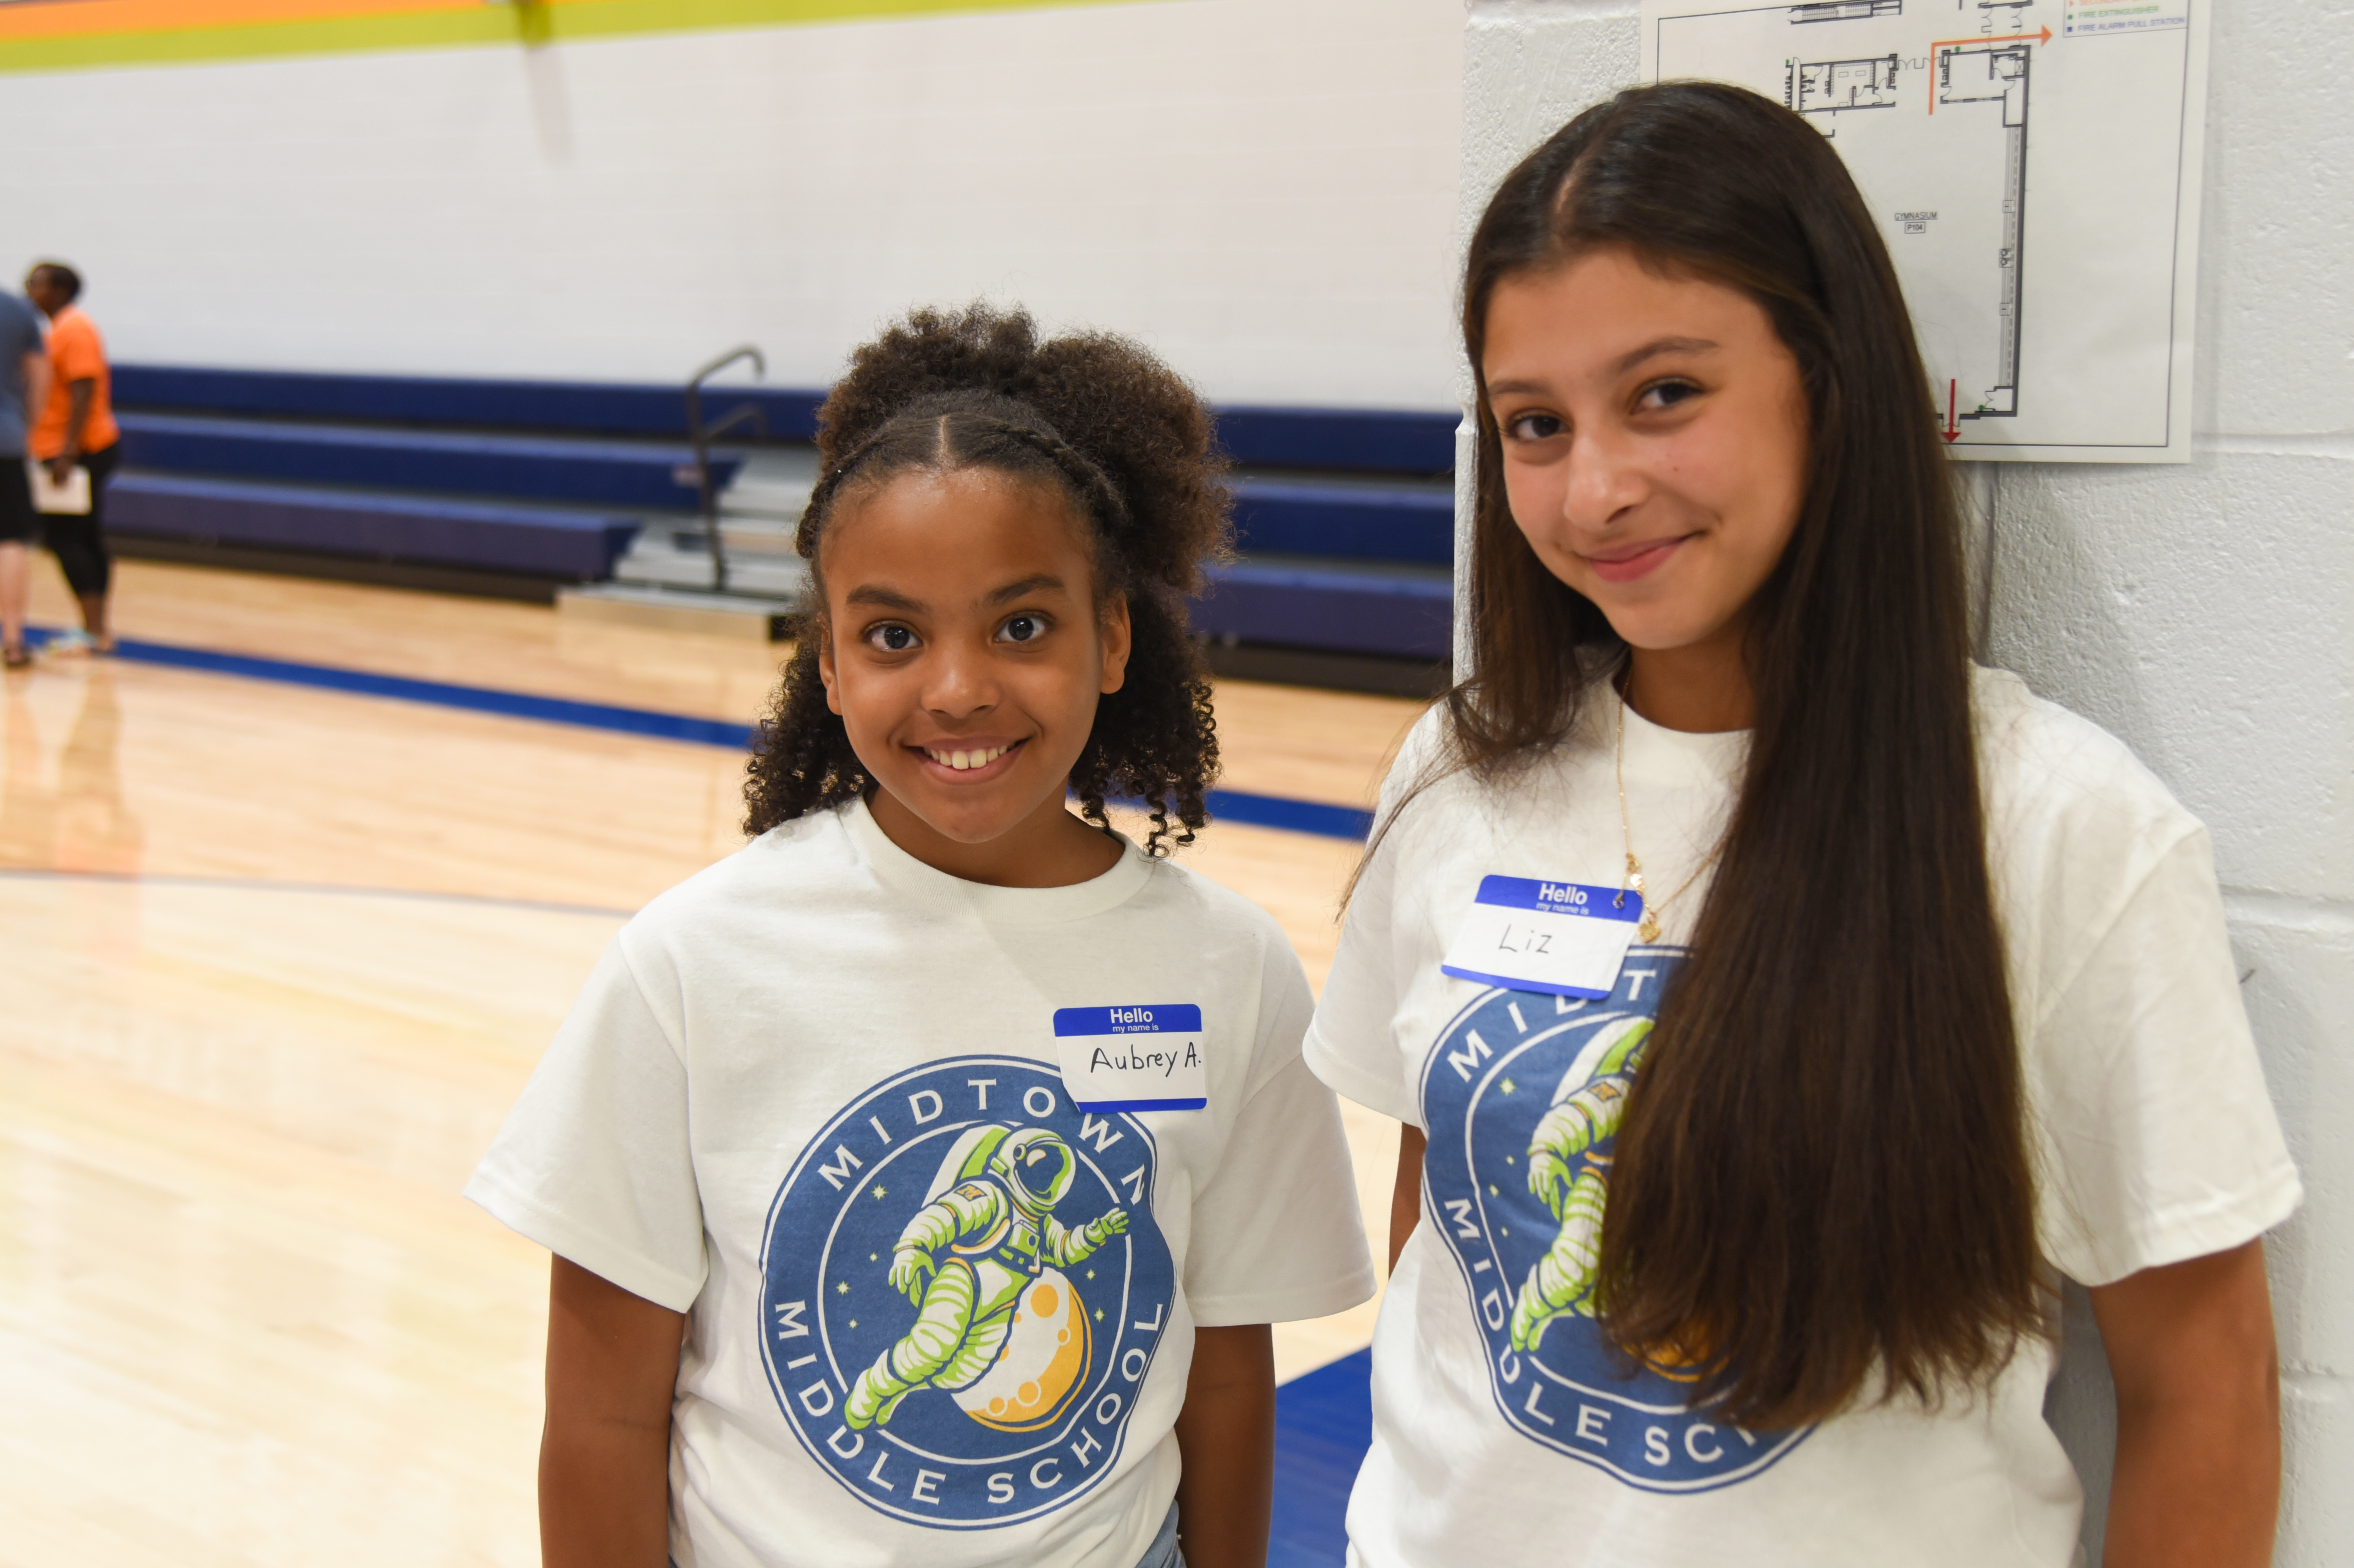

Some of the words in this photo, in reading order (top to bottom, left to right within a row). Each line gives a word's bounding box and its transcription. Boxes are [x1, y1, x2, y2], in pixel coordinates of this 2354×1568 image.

[2099, 6, 2159, 17] EXTINGUISHER
[2150, 17, 2185, 26] STATION
[1894, 212, 1937, 220] GYMNASIUM
[1538, 882, 1588, 905] Hello
[1536, 902, 1551, 912] my
[1552, 904, 1579, 914] name
[1580, 906, 1590, 916] is
[1110, 1007, 1153, 1024] Hello
[1091, 1044, 1177, 1078] Aubrey
[1185, 1042, 1201, 1068] A.
[1445, 1199, 1611, 1447] MIDDLE
[775, 1299, 946, 1506] MIDDLE
[986, 1302, 1164, 1504] SCHOOL
